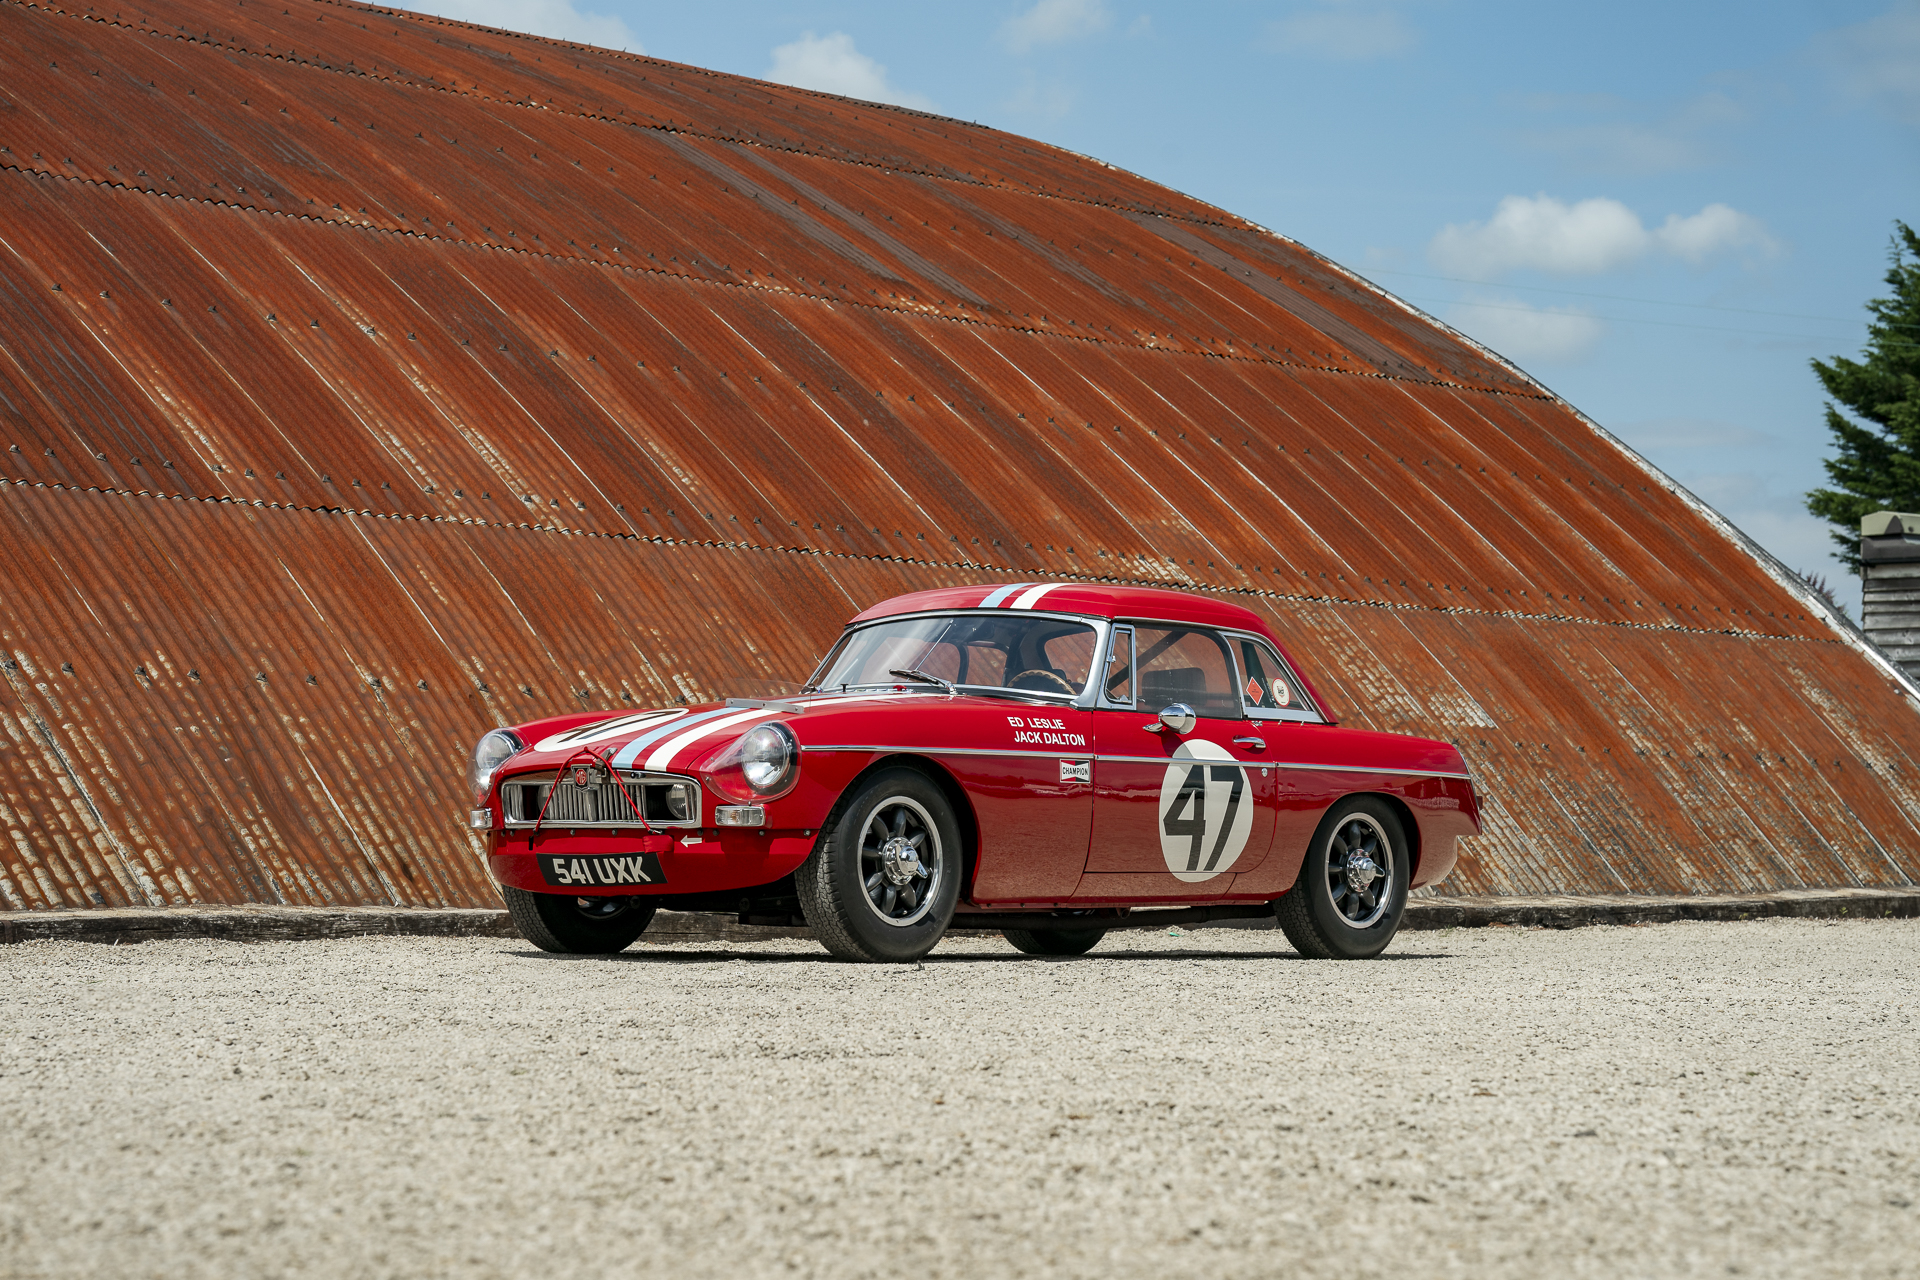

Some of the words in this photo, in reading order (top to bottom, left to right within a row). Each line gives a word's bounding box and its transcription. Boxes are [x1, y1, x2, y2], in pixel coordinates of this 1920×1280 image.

[1007, 716, 1024, 727] ED
[1027, 717, 1066, 729] LESLIE
[1014, 731, 1043, 743] JACK
[1043, 732, 1086, 746] DALTON
[1062, 766, 1089, 775] CHAMPION
[1163, 764, 1244, 871] 47
[552, 858, 595, 884] 541
[593, 856, 652, 883] UXK
